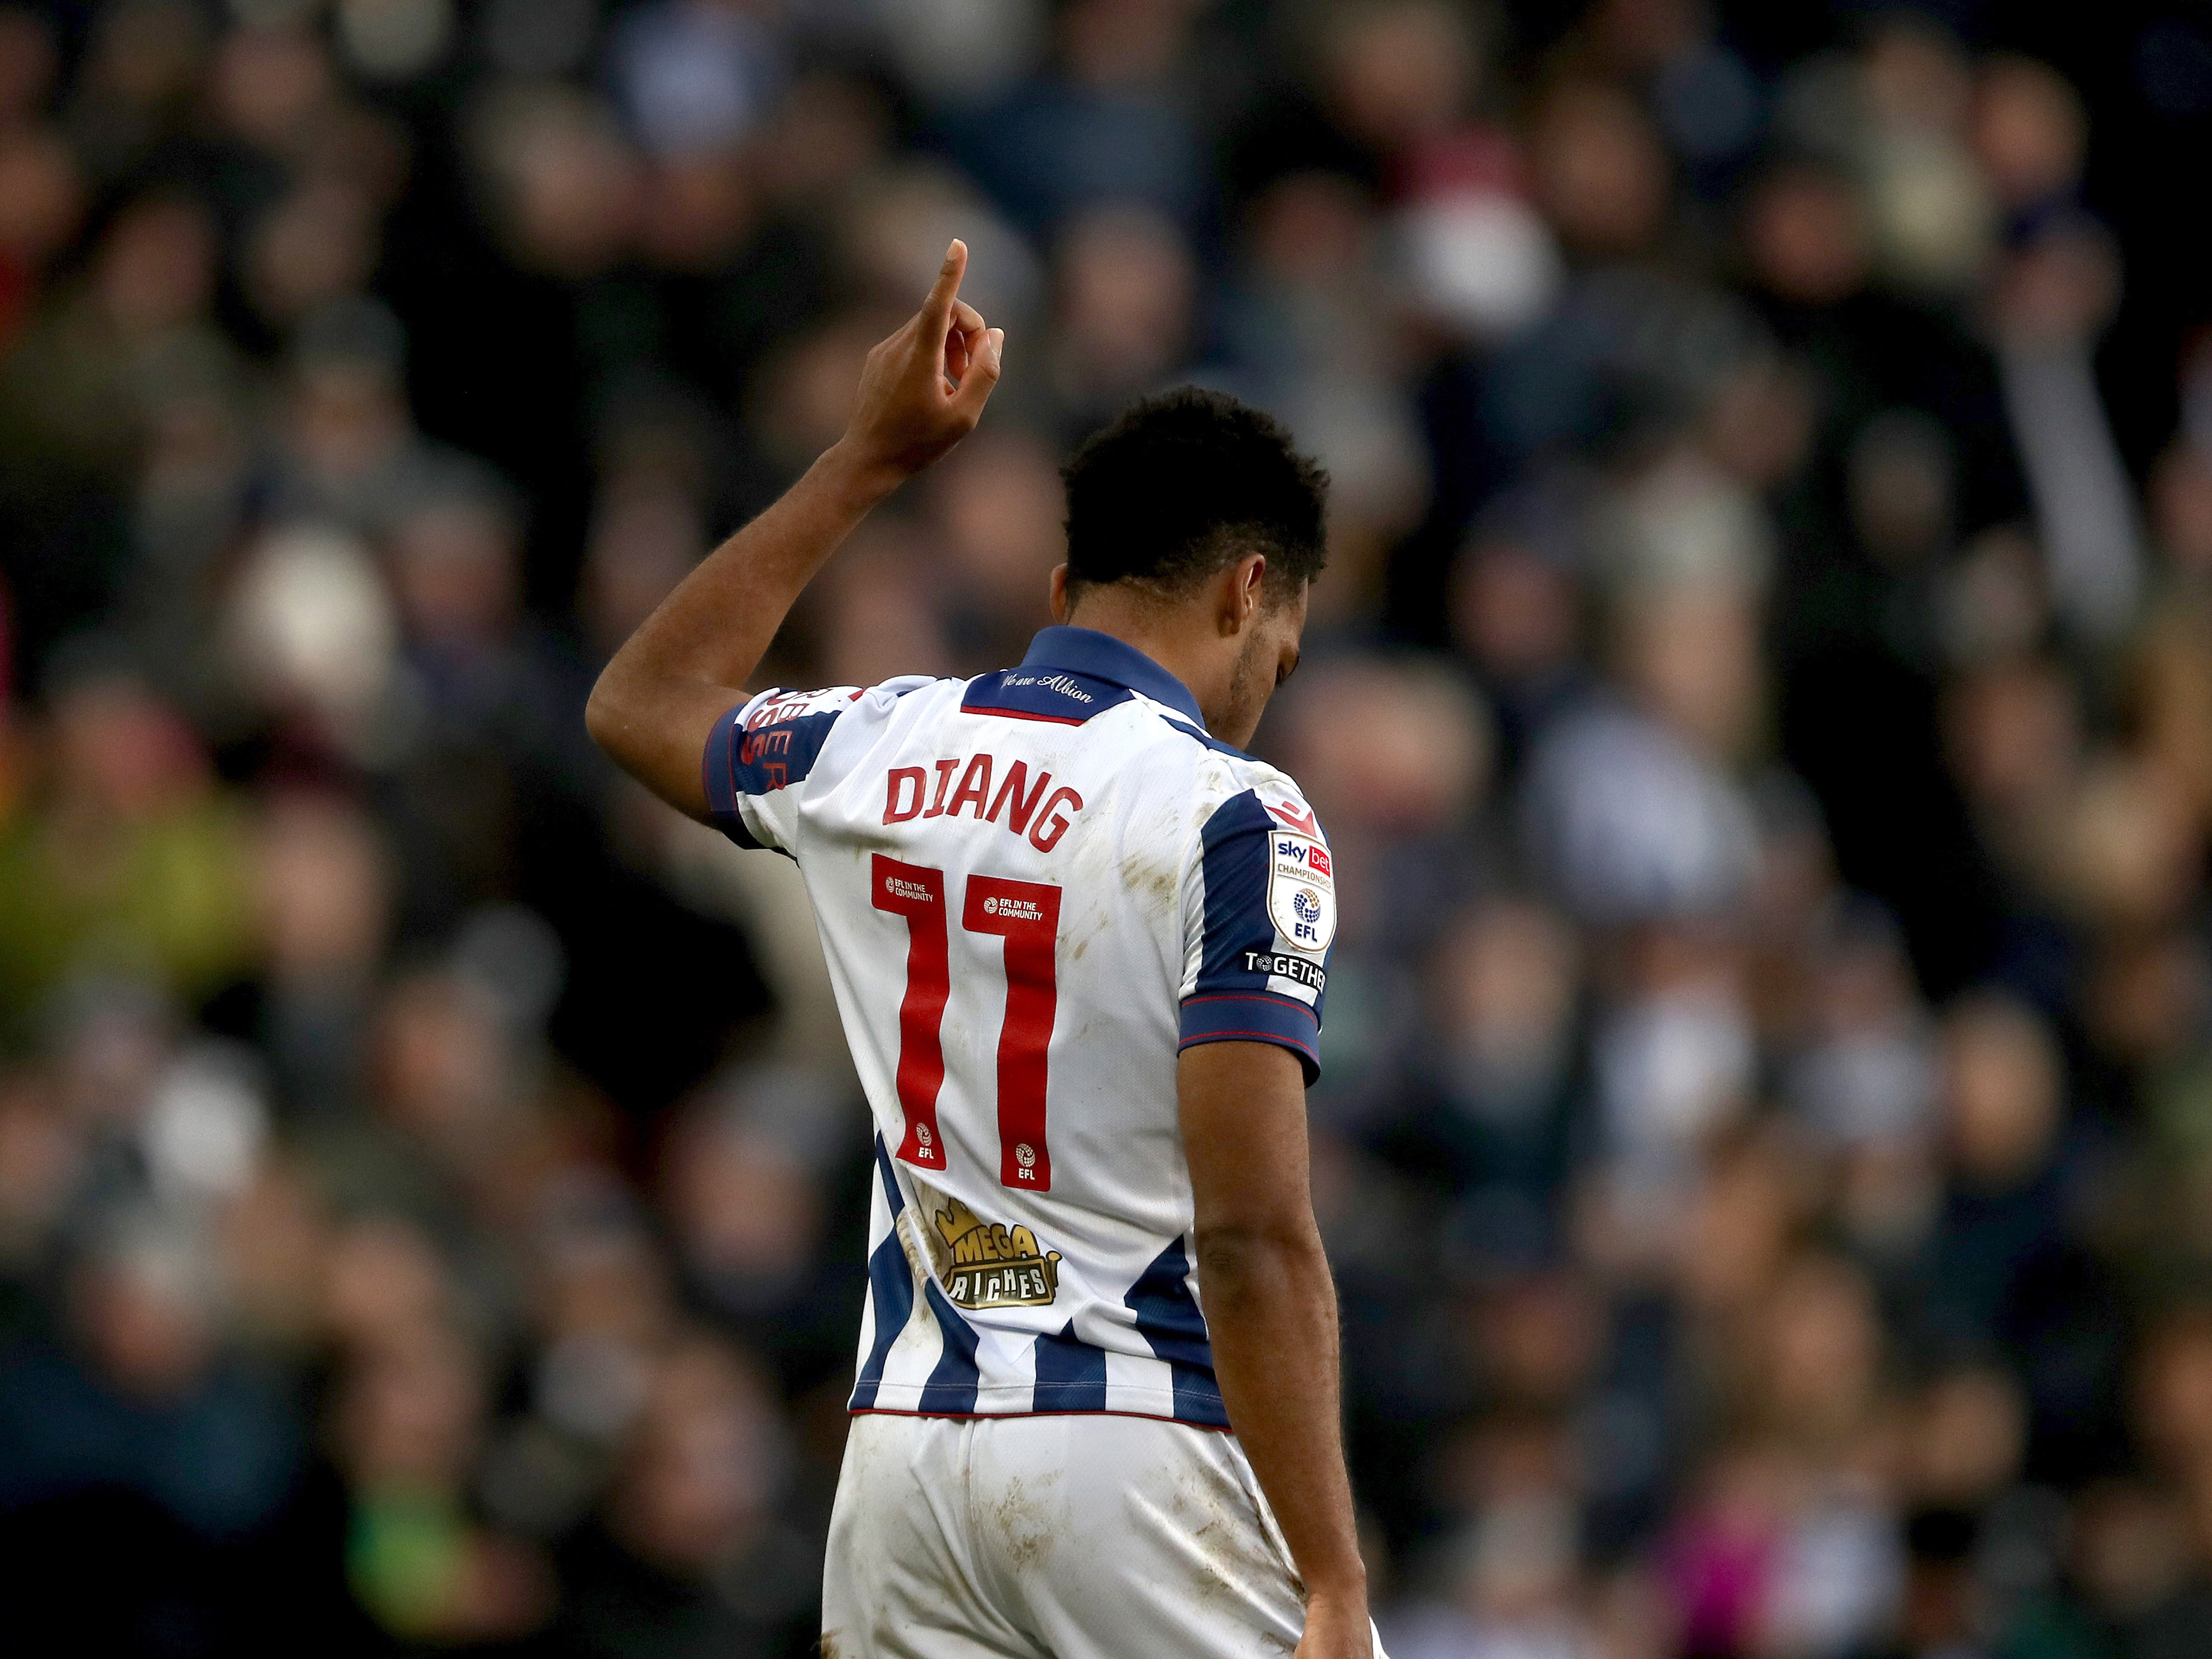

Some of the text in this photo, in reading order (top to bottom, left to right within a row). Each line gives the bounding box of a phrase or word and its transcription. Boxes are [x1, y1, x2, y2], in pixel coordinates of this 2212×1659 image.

[1015, 676, 1035, 686] are
[1037, 675, 1094, 703] Albion
[883, 754, 1083, 853] DIANG
[1278, 840, 1329, 872] sky bet
[895, 878, 925, 893] EFL IN THE
[1278, 863, 1331, 889] CHAMPIONSHIP
[895, 887, 933, 902] COMMUNITY
[1000, 898, 1036, 910] EFL IN THE
[998, 907, 1043, 921] COMMUNITY
[1295, 922, 1317, 943] EFL
[871, 853, 1062, 1192] 11
[918, 1147, 934, 1160] EFL
[1019, 1167, 1035, 1180] EFL
[954, 1224, 1039, 1264] MEGA
[949, 1268, 1046, 1301] RICHES
